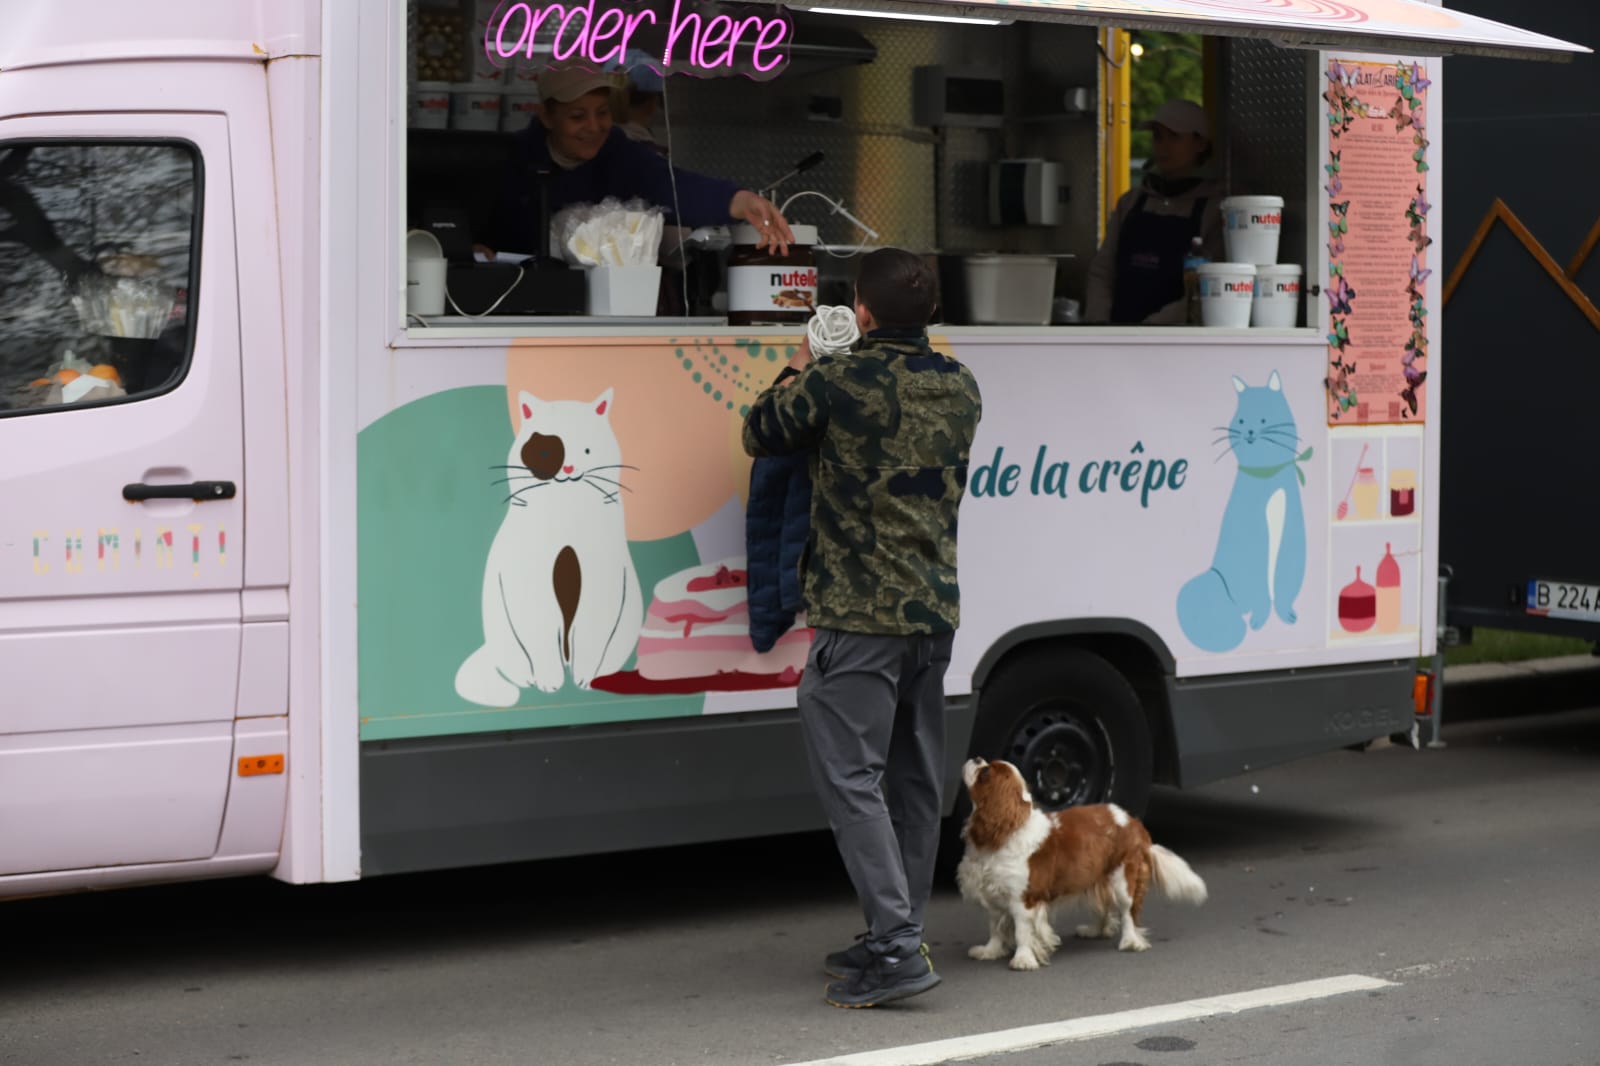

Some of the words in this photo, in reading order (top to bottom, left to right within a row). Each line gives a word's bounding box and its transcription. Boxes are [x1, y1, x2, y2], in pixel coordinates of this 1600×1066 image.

[495, 0, 656, 64] order
[662, 0, 787, 72] here
[970, 446, 1021, 498] de
[1030, 445, 1071, 499] la
[1079, 441, 1189, 508] crêpe
[1537, 583, 1550, 607] B
[1558, 585, 1590, 611] 224
